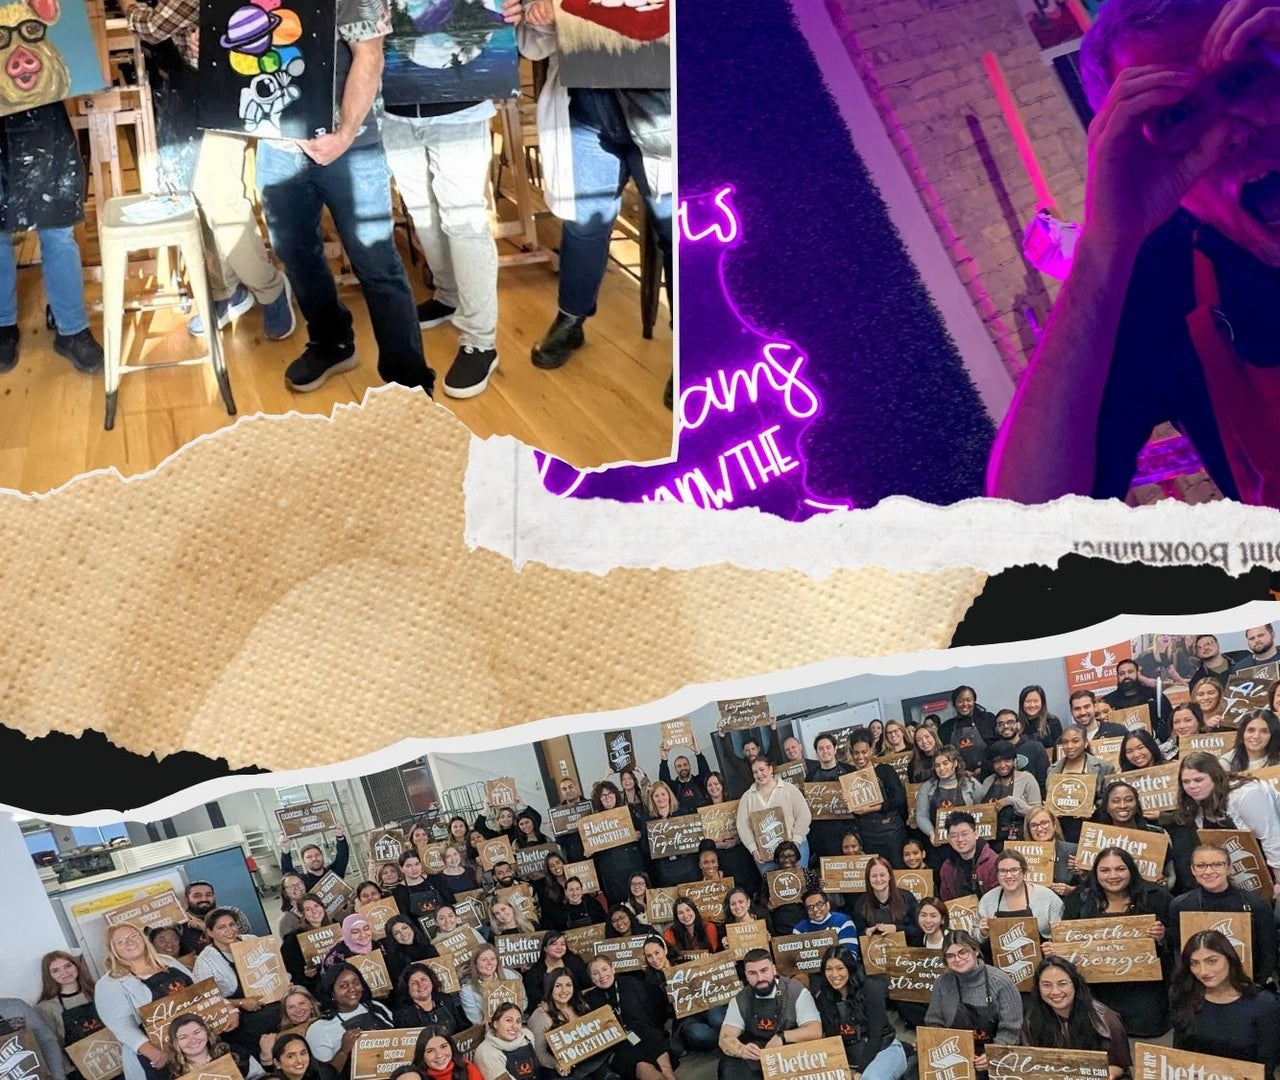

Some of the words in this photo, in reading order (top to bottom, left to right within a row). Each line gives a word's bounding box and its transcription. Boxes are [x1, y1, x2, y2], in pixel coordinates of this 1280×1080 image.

[680, 343, 819, 430] ams
[724, 425, 801, 491] THE
[1075, 673, 1095, 683] PAINT
[1104, 669, 1118, 679] CAB
[1190, 737, 1225, 750] SUCCESS
[1136, 773, 1171, 792] etter
[851, 789, 878, 807] TJX
[1058, 798, 1080, 807] SUCCESS
[590, 818, 620, 833] better
[587, 829, 631, 846] TOGETHER
[1099, 830, 1147, 853] better
[376, 845, 400, 860] TJX
[522, 849, 549, 863] better
[519, 862, 546, 875] TOGET
[1081, 850, 1157, 877] TOER
[685, 883, 728, 899] together
[307, 928, 334, 943] SUCCESS
[1066, 925, 1143, 949] together
[506, 937, 540, 953] better
[500, 951, 541, 967] TOGETH
[895, 956, 946, 974] togethe
[1068, 952, 1160, 976] tronger
[667, 967, 717, 991] Alone
[888, 976, 934, 992] stron
[667, 981, 730, 1012] Together
[147, 994, 202, 1028] Alone
[561, 1018, 601, 1047] better
[557, 1025, 622, 1064] TOGETHER
[778, 1050, 829, 1073] better
[990, 1052, 1079, 1076] Alone
